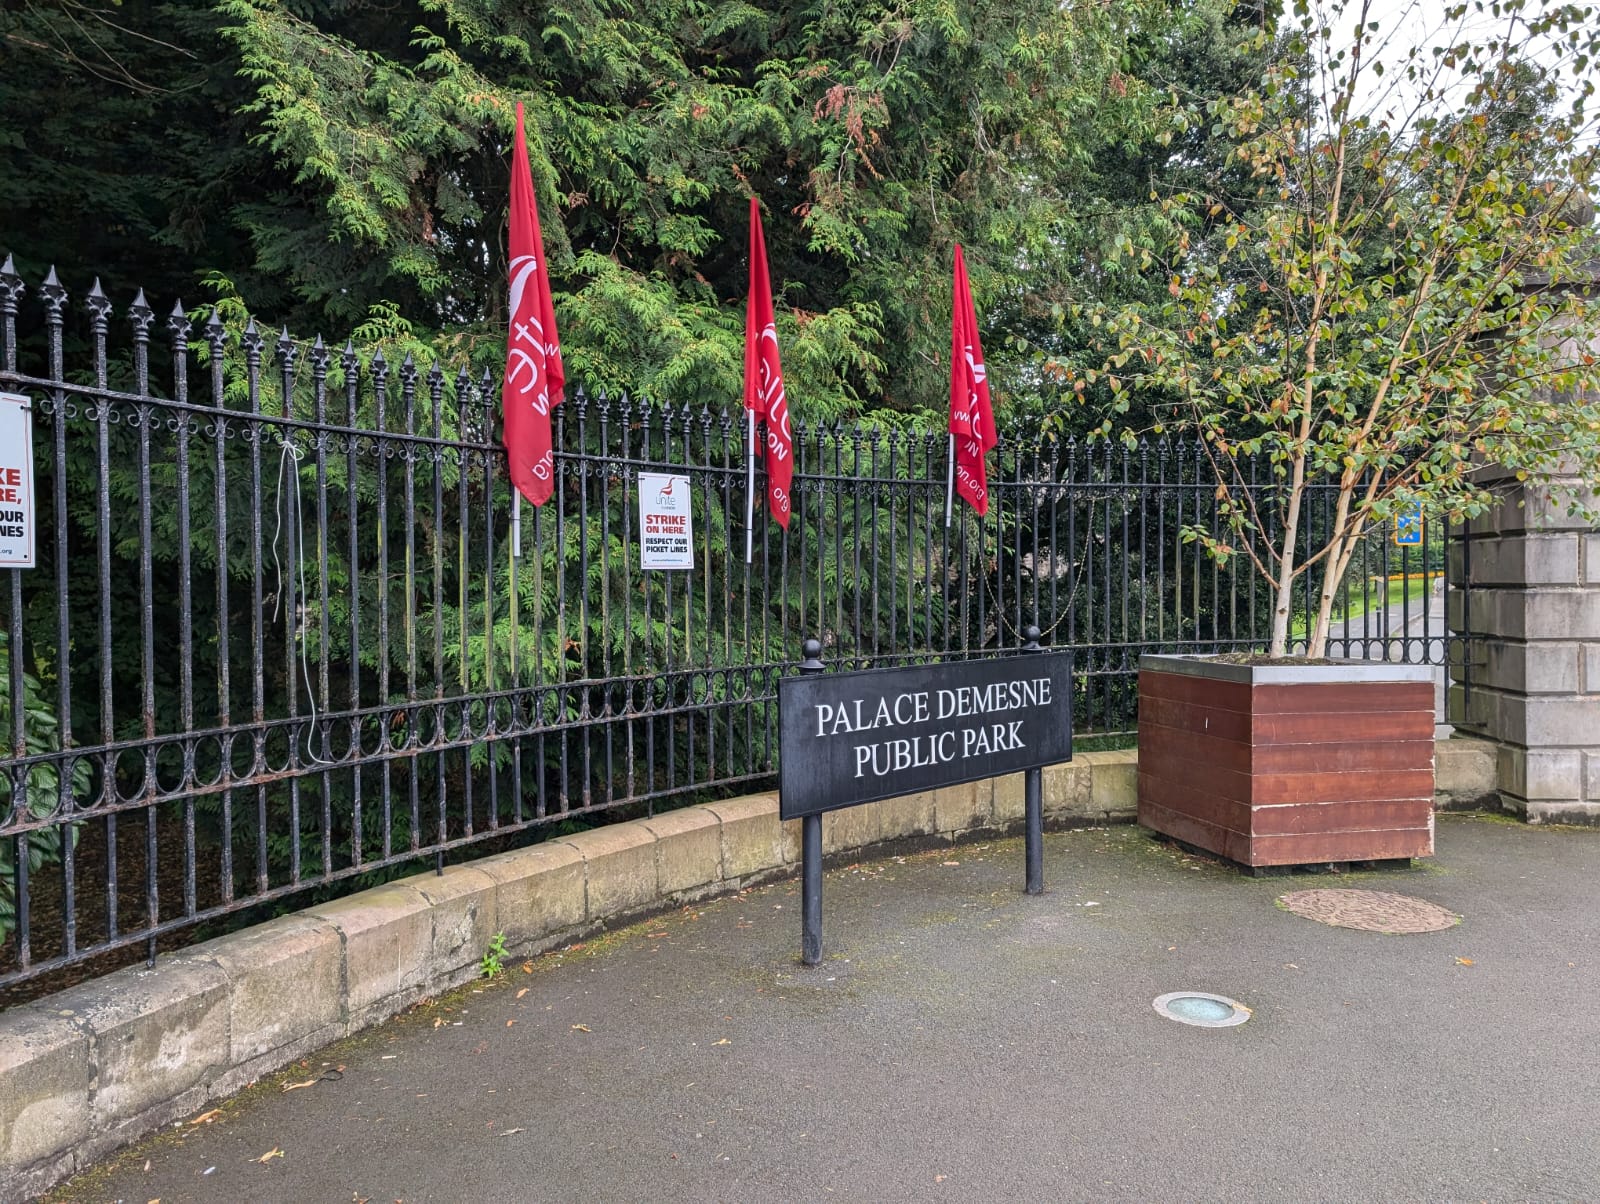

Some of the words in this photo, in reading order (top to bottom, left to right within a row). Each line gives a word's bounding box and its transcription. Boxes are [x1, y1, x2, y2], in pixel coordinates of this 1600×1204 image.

[646, 514, 686, 525] STRIKE
[646, 526, 659, 534] ON
[815, 692, 930, 737] PALACE
[936, 678, 1052, 719] DEMESNE
[853, 731, 956, 778] PUBLIC
[961, 720, 1026, 758] PARK
